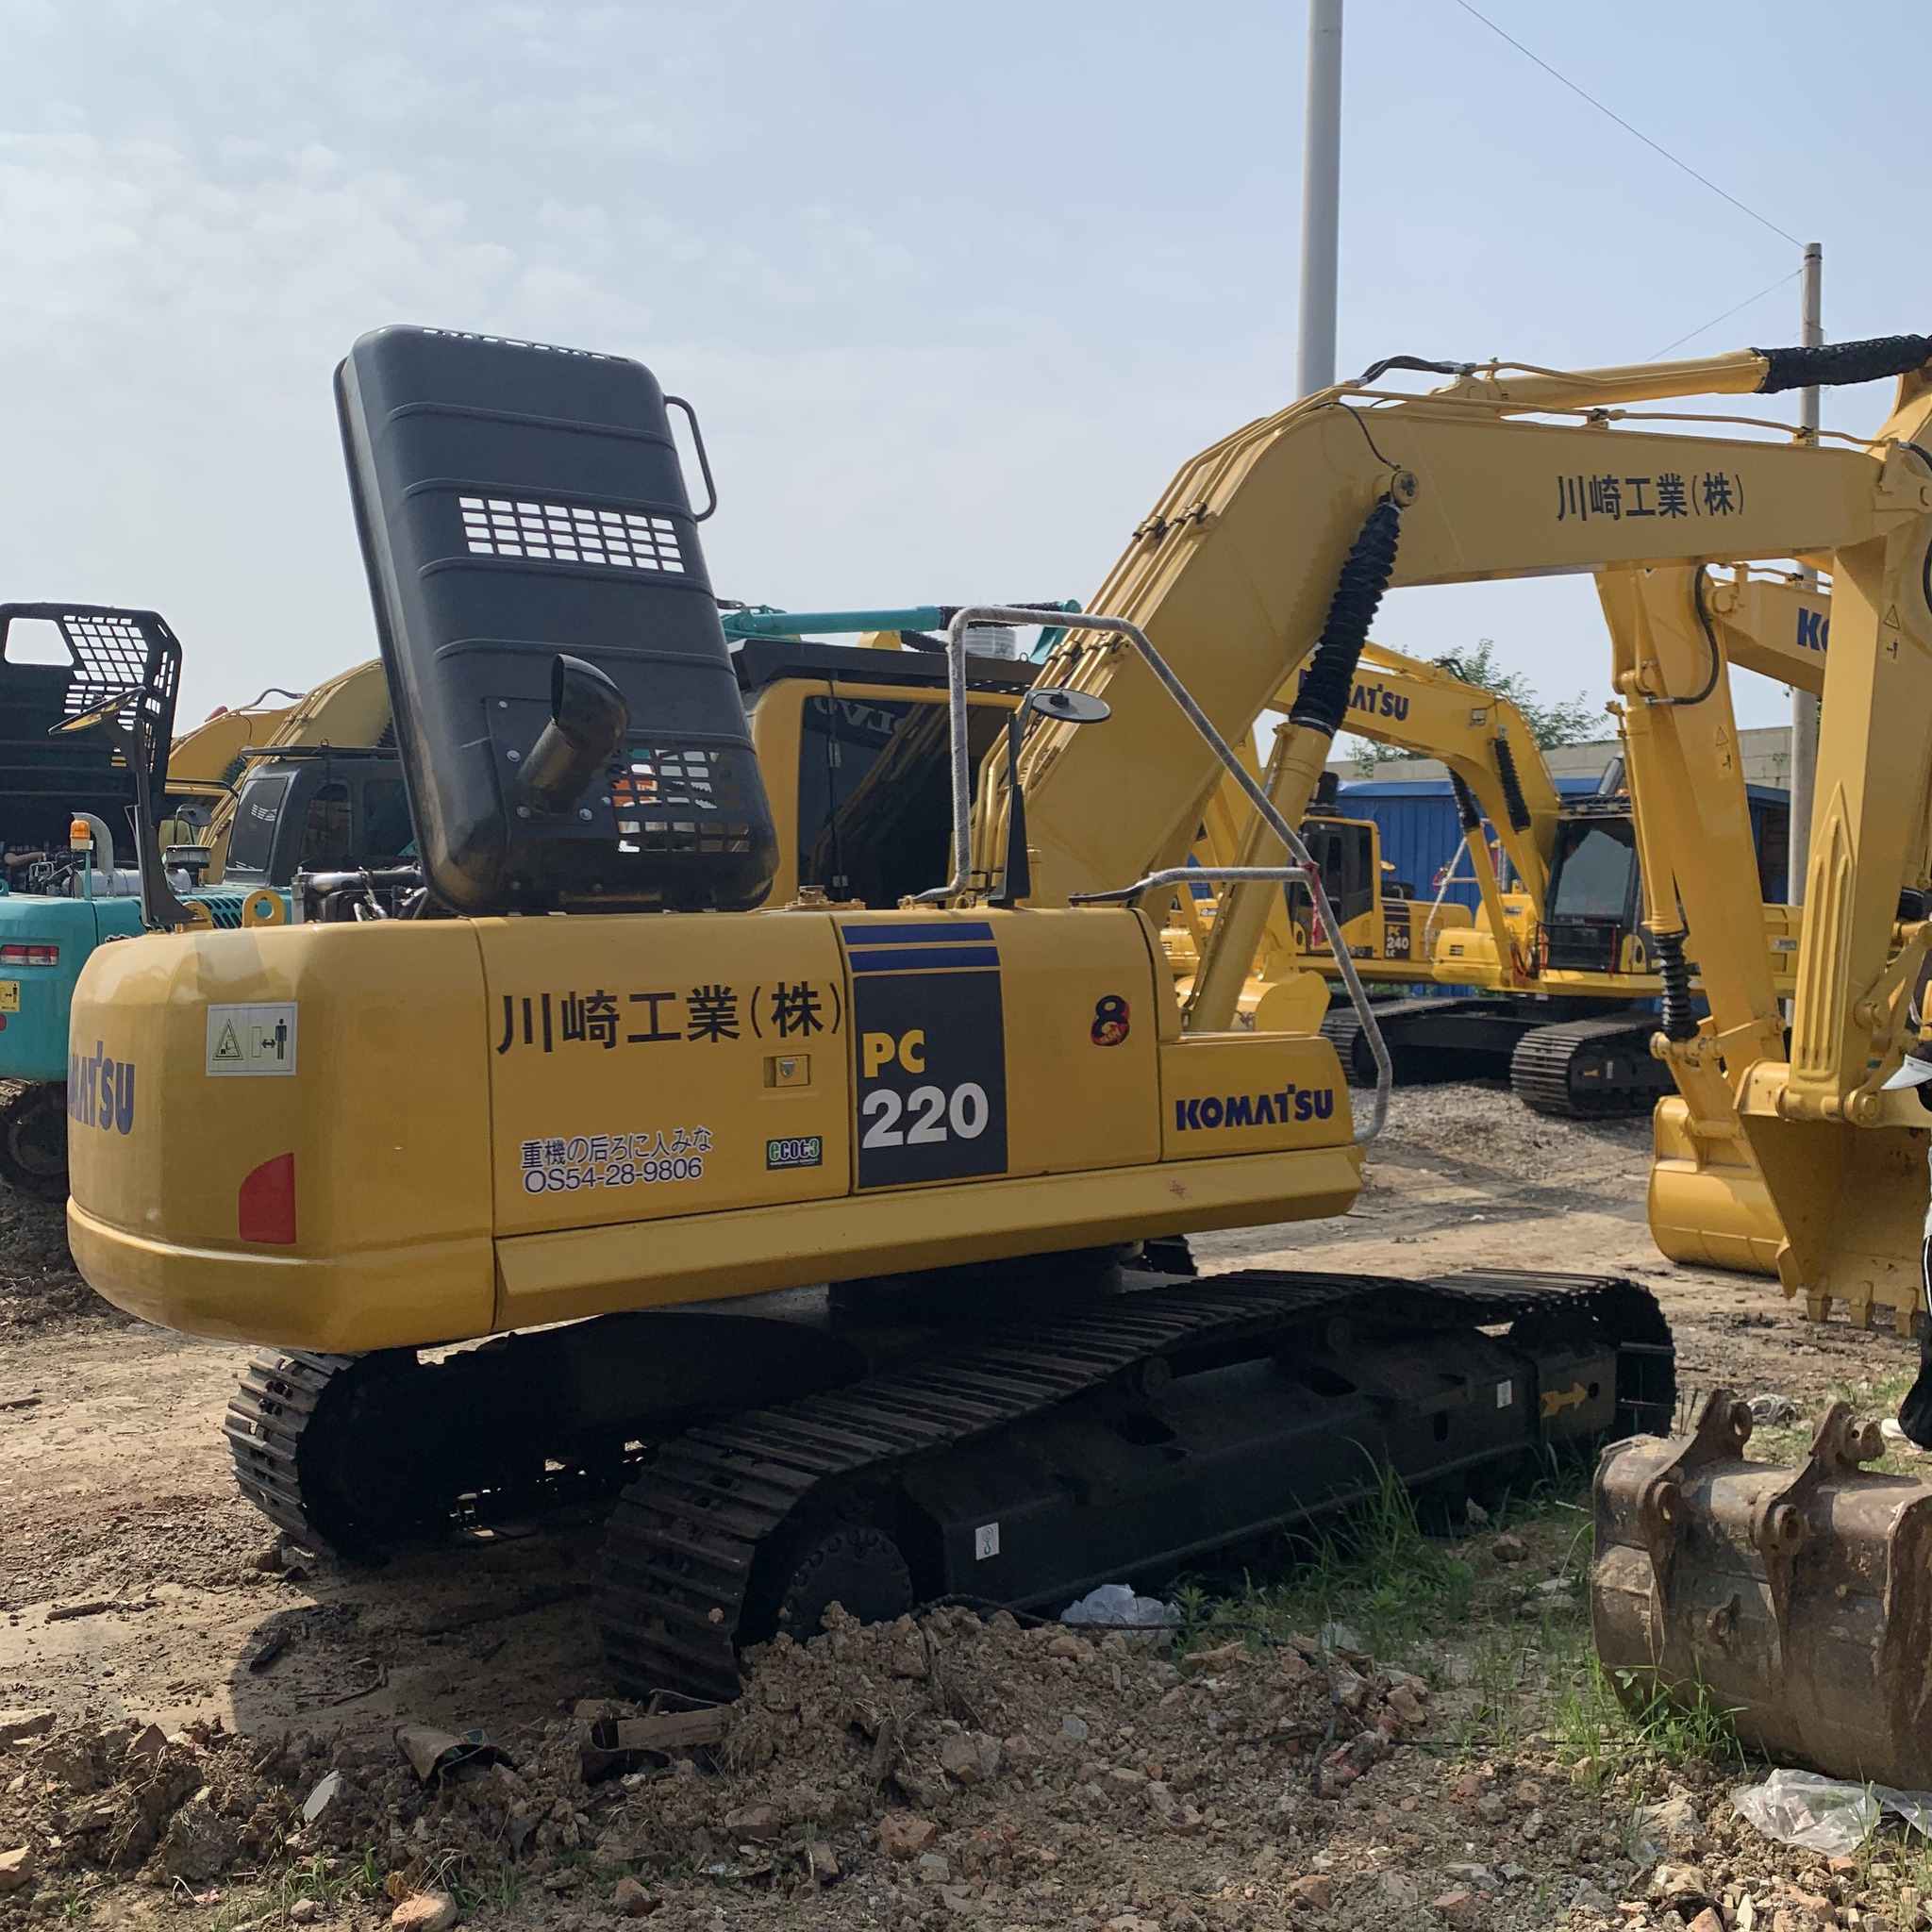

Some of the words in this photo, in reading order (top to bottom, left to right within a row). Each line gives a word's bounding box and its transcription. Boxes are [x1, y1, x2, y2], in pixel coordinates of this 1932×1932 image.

[1557, 472, 1743, 521] 川崎工業(株)
[1386, 936, 1410, 950] 240
[498, 981, 841, 1055] 川崎工業(株)
[862, 1028, 925, 1078] PC
[861, 1082, 989, 1149] 220
[1175, 1084, 1333, 1131] KOMATSU
